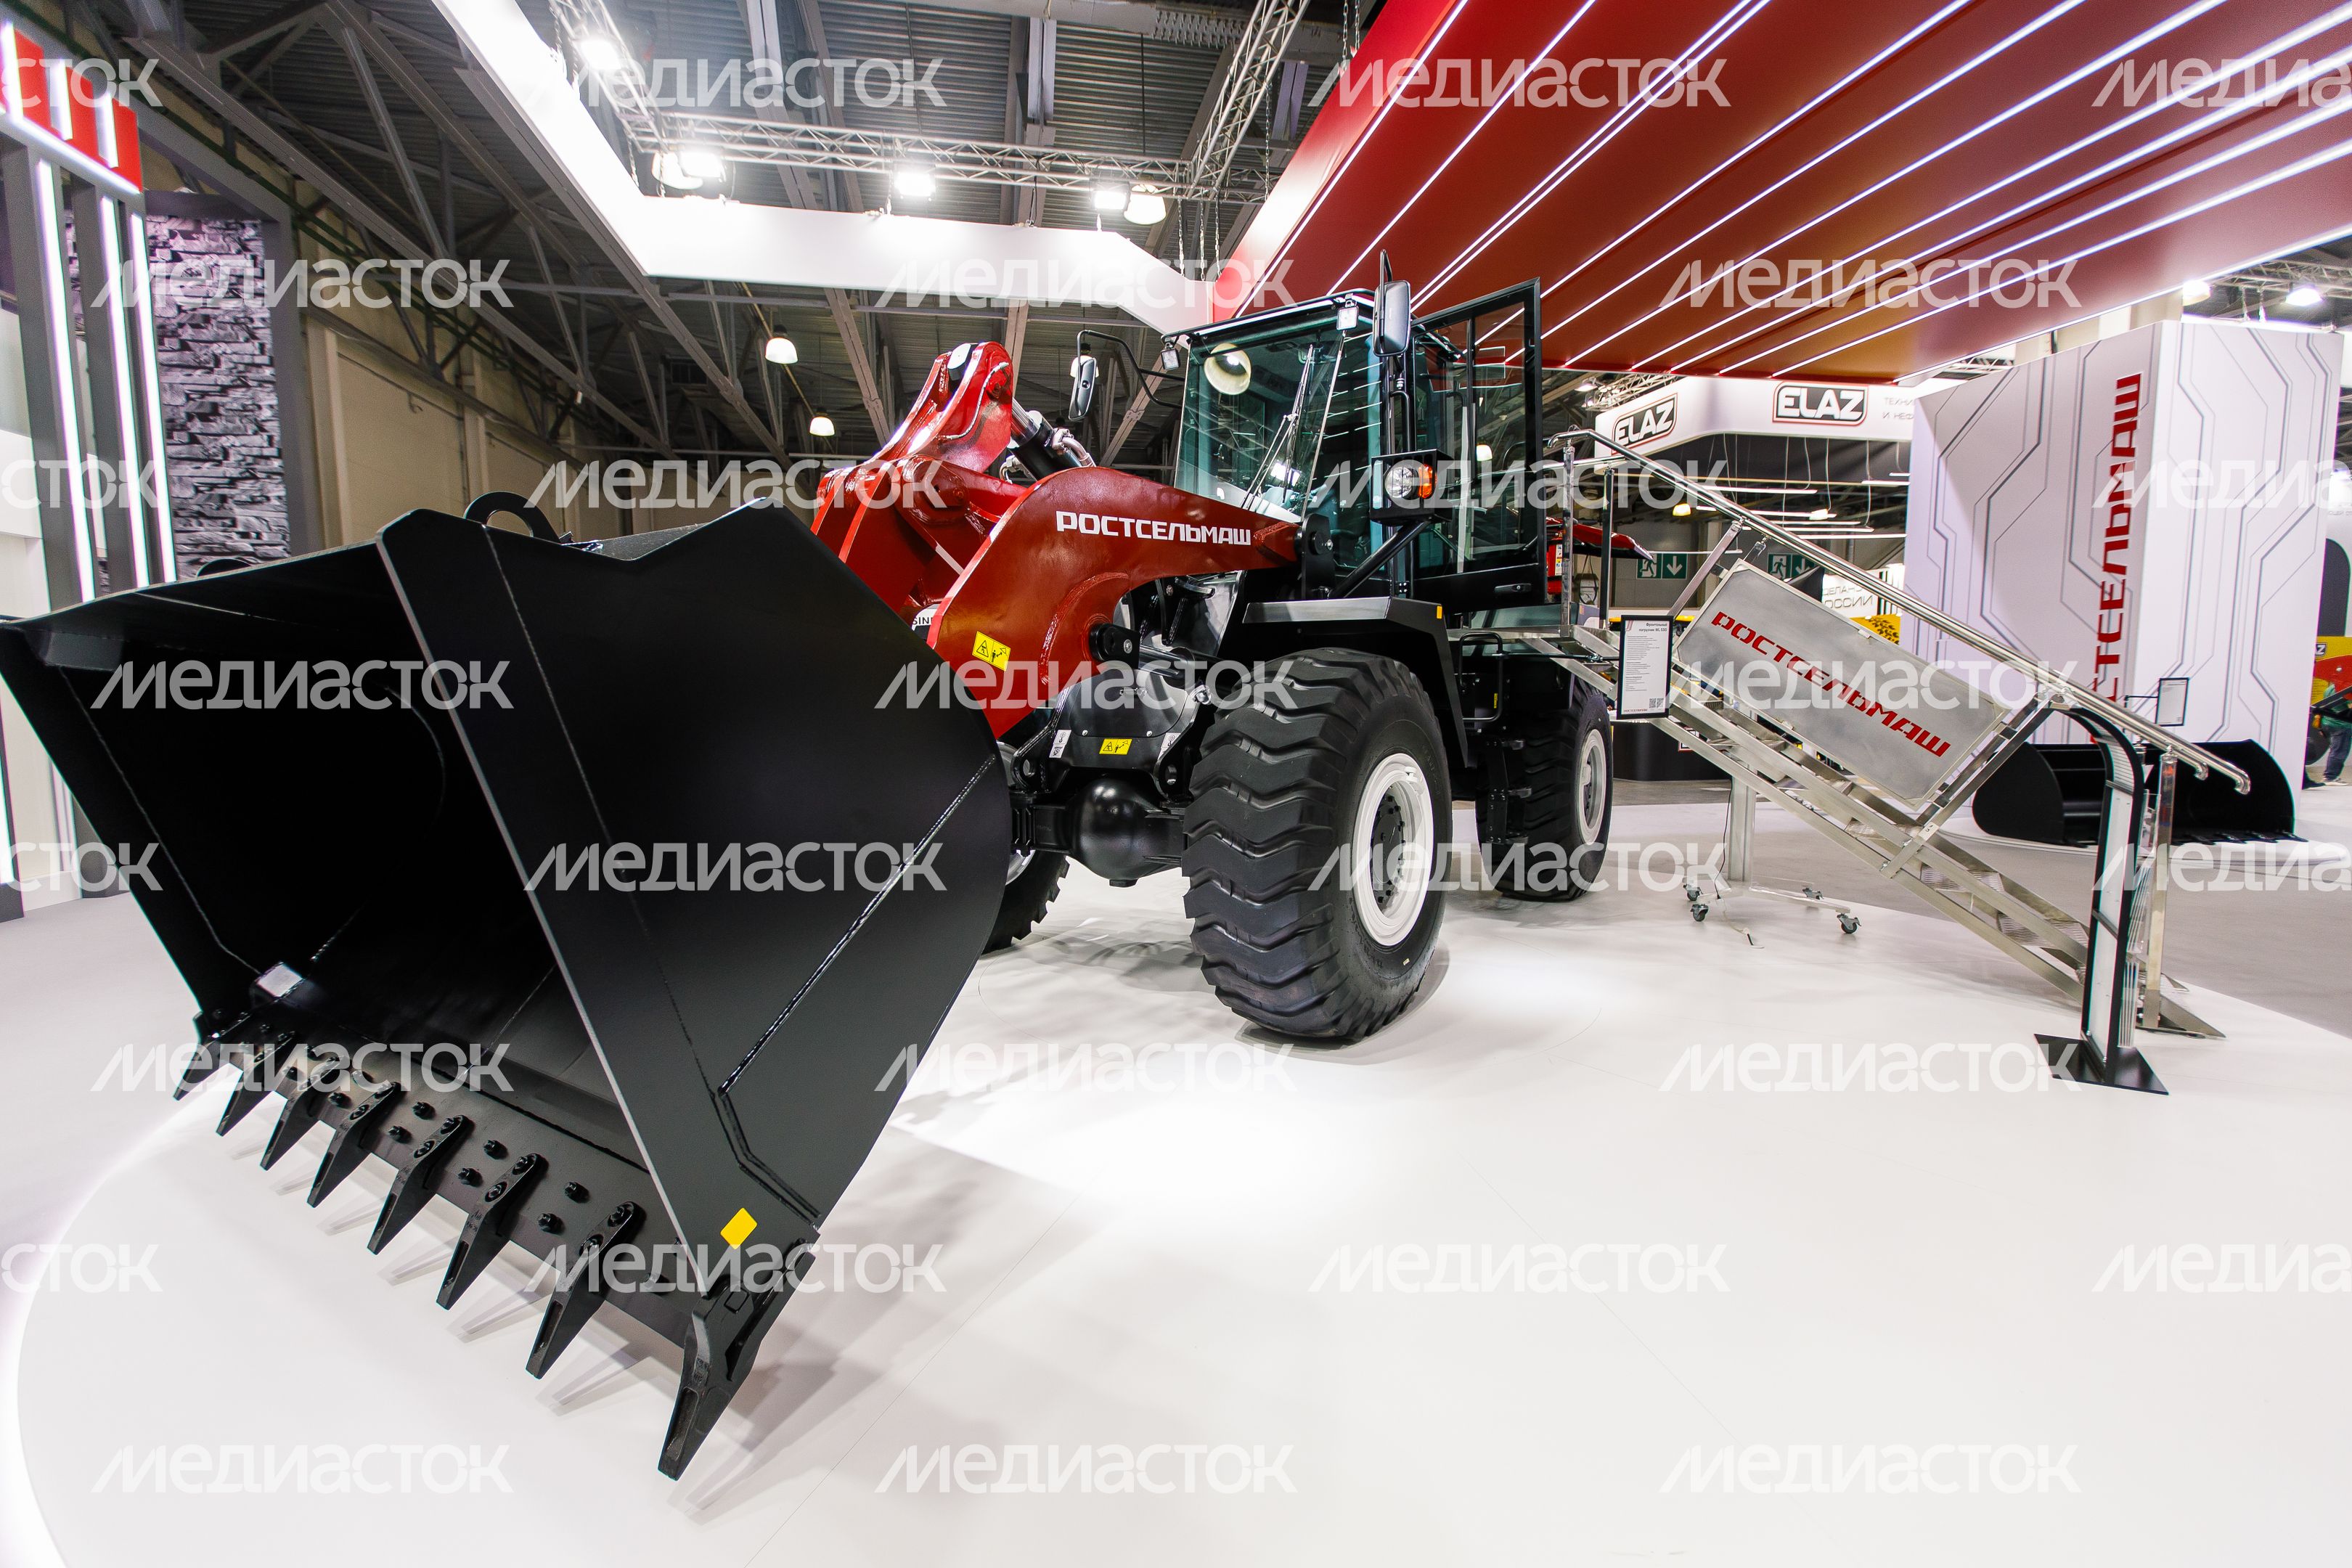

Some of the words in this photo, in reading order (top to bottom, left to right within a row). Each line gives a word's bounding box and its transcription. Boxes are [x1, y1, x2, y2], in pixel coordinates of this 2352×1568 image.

[1780, 388, 1866, 420] ELAZ
[1614, 399, 1675, 446] ELAZ
[1055, 510, 1251, 546] РОСТСЕЛЬМАШ
[912, 616, 933, 625] SIN
[1711, 611, 1951, 758] РОСТСЕЛЬМАШ
